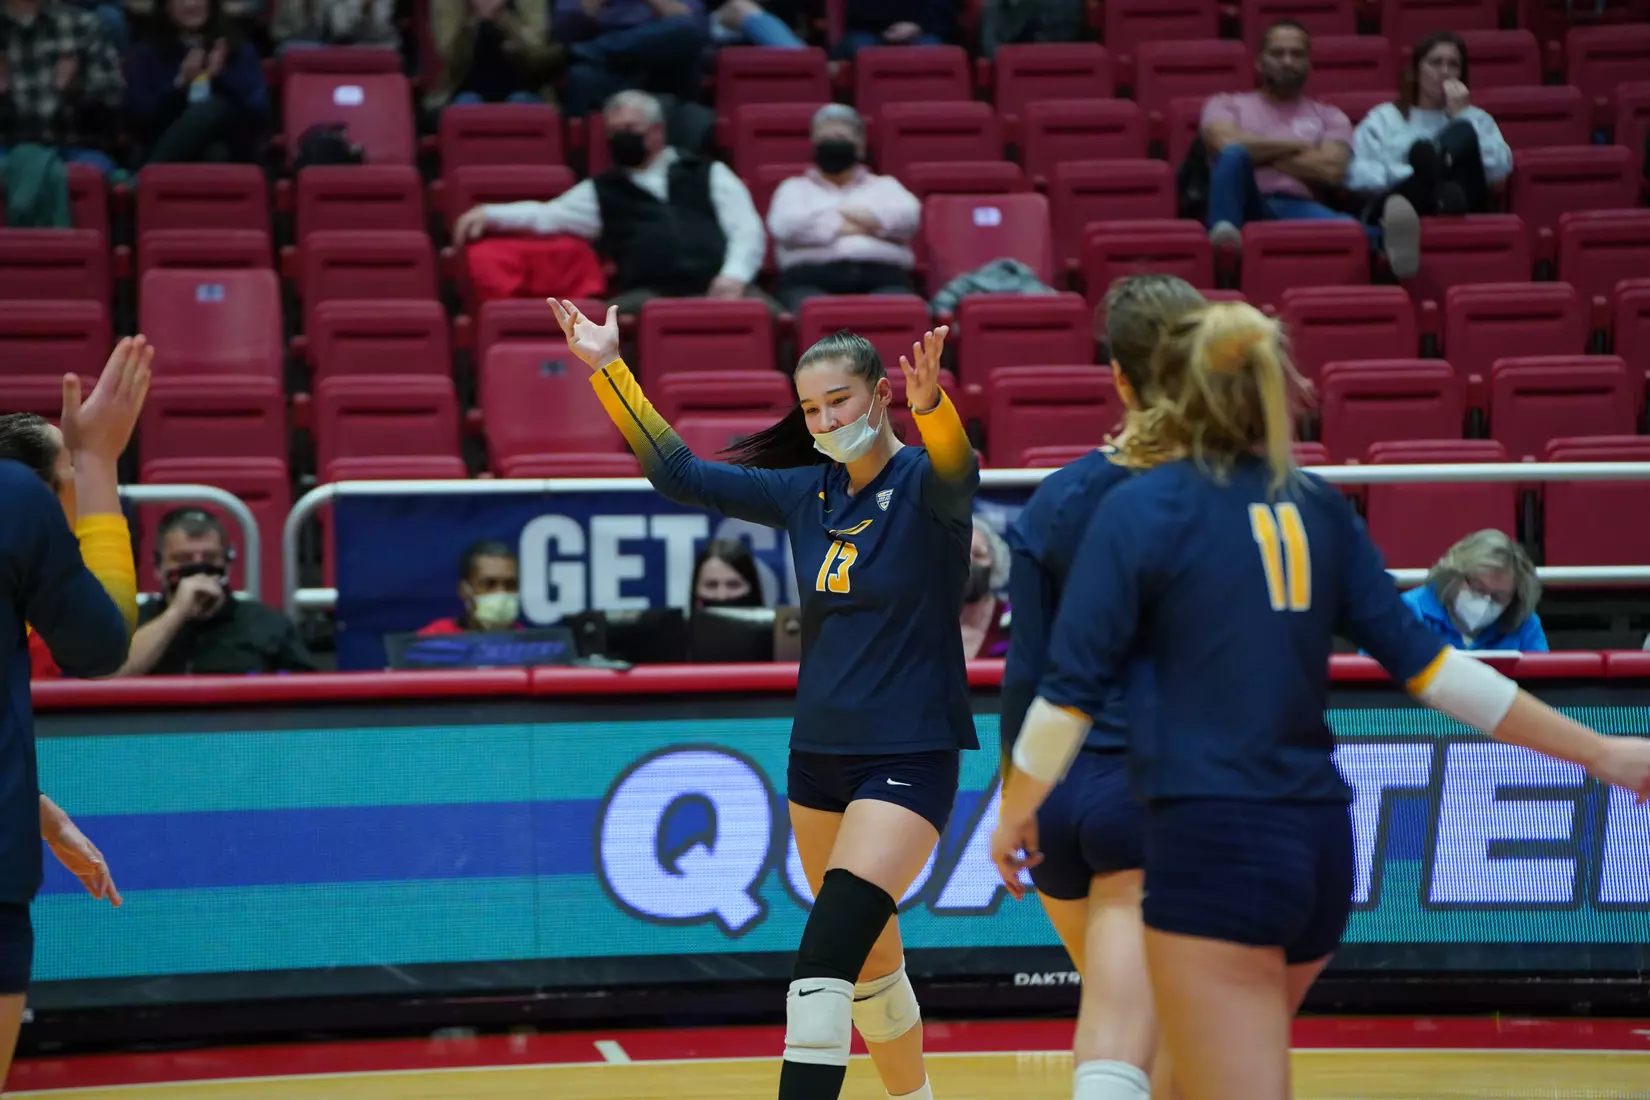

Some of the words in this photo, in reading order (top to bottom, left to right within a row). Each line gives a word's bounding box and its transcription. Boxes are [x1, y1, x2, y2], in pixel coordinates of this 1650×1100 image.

[816, 539, 858, 593] 13
[1248, 502, 1311, 611] 11
[1014, 972, 1083, 985] DAKTR
